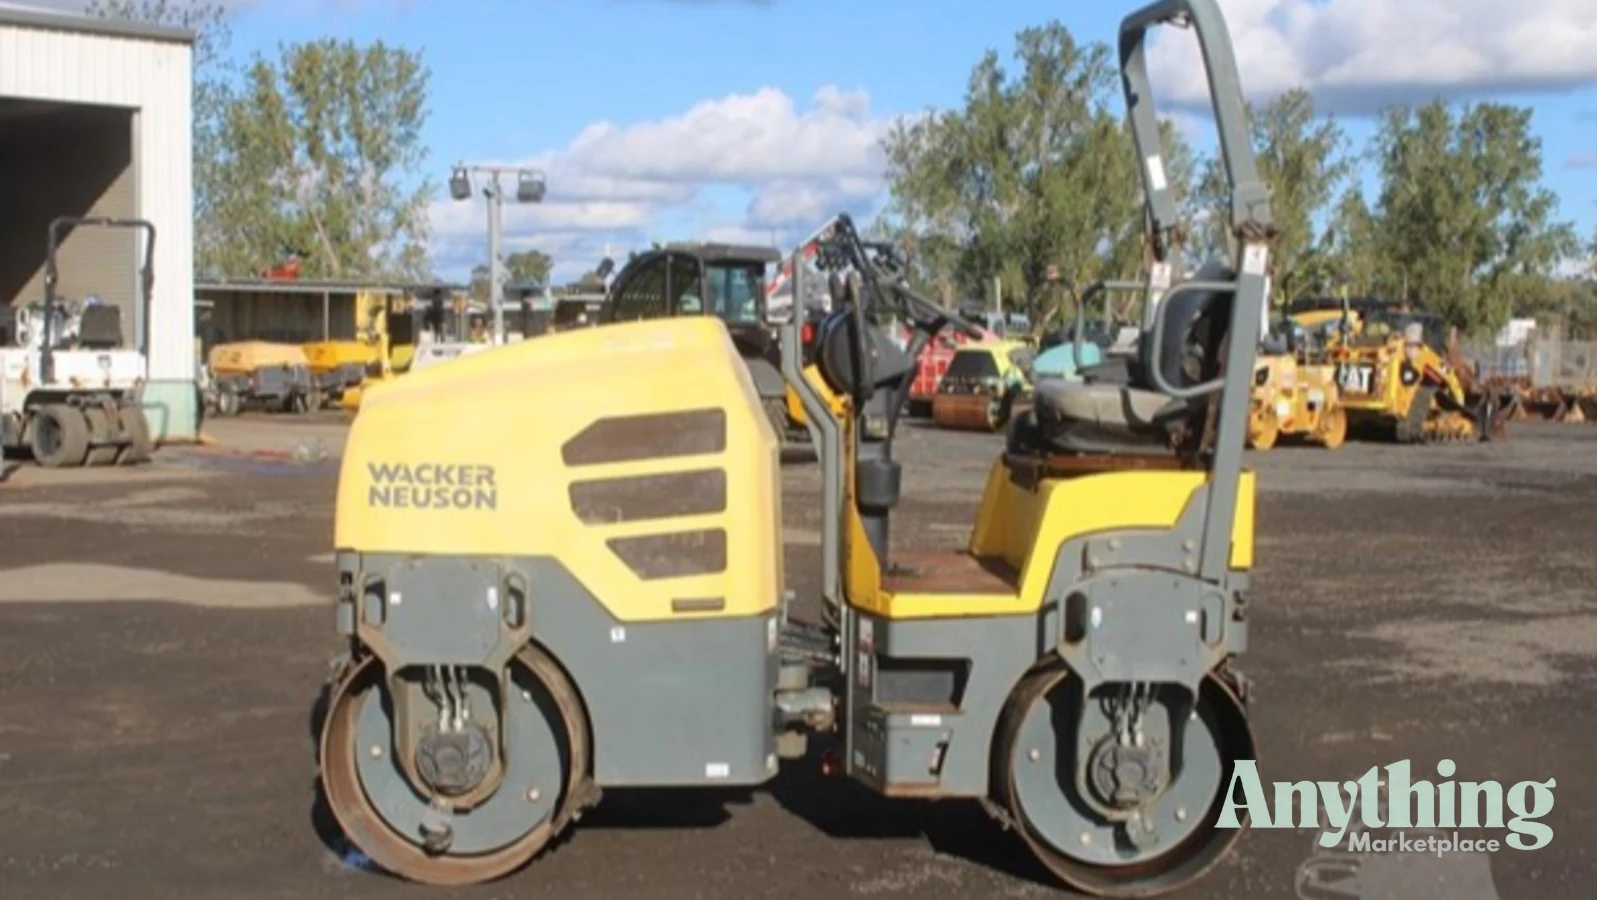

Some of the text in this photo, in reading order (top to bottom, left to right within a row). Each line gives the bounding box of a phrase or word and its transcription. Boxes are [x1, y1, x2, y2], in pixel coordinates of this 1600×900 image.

[1340, 362, 1373, 394] CAT
[367, 462, 496, 486] WACKER
[368, 486, 498, 509] NEUSON
